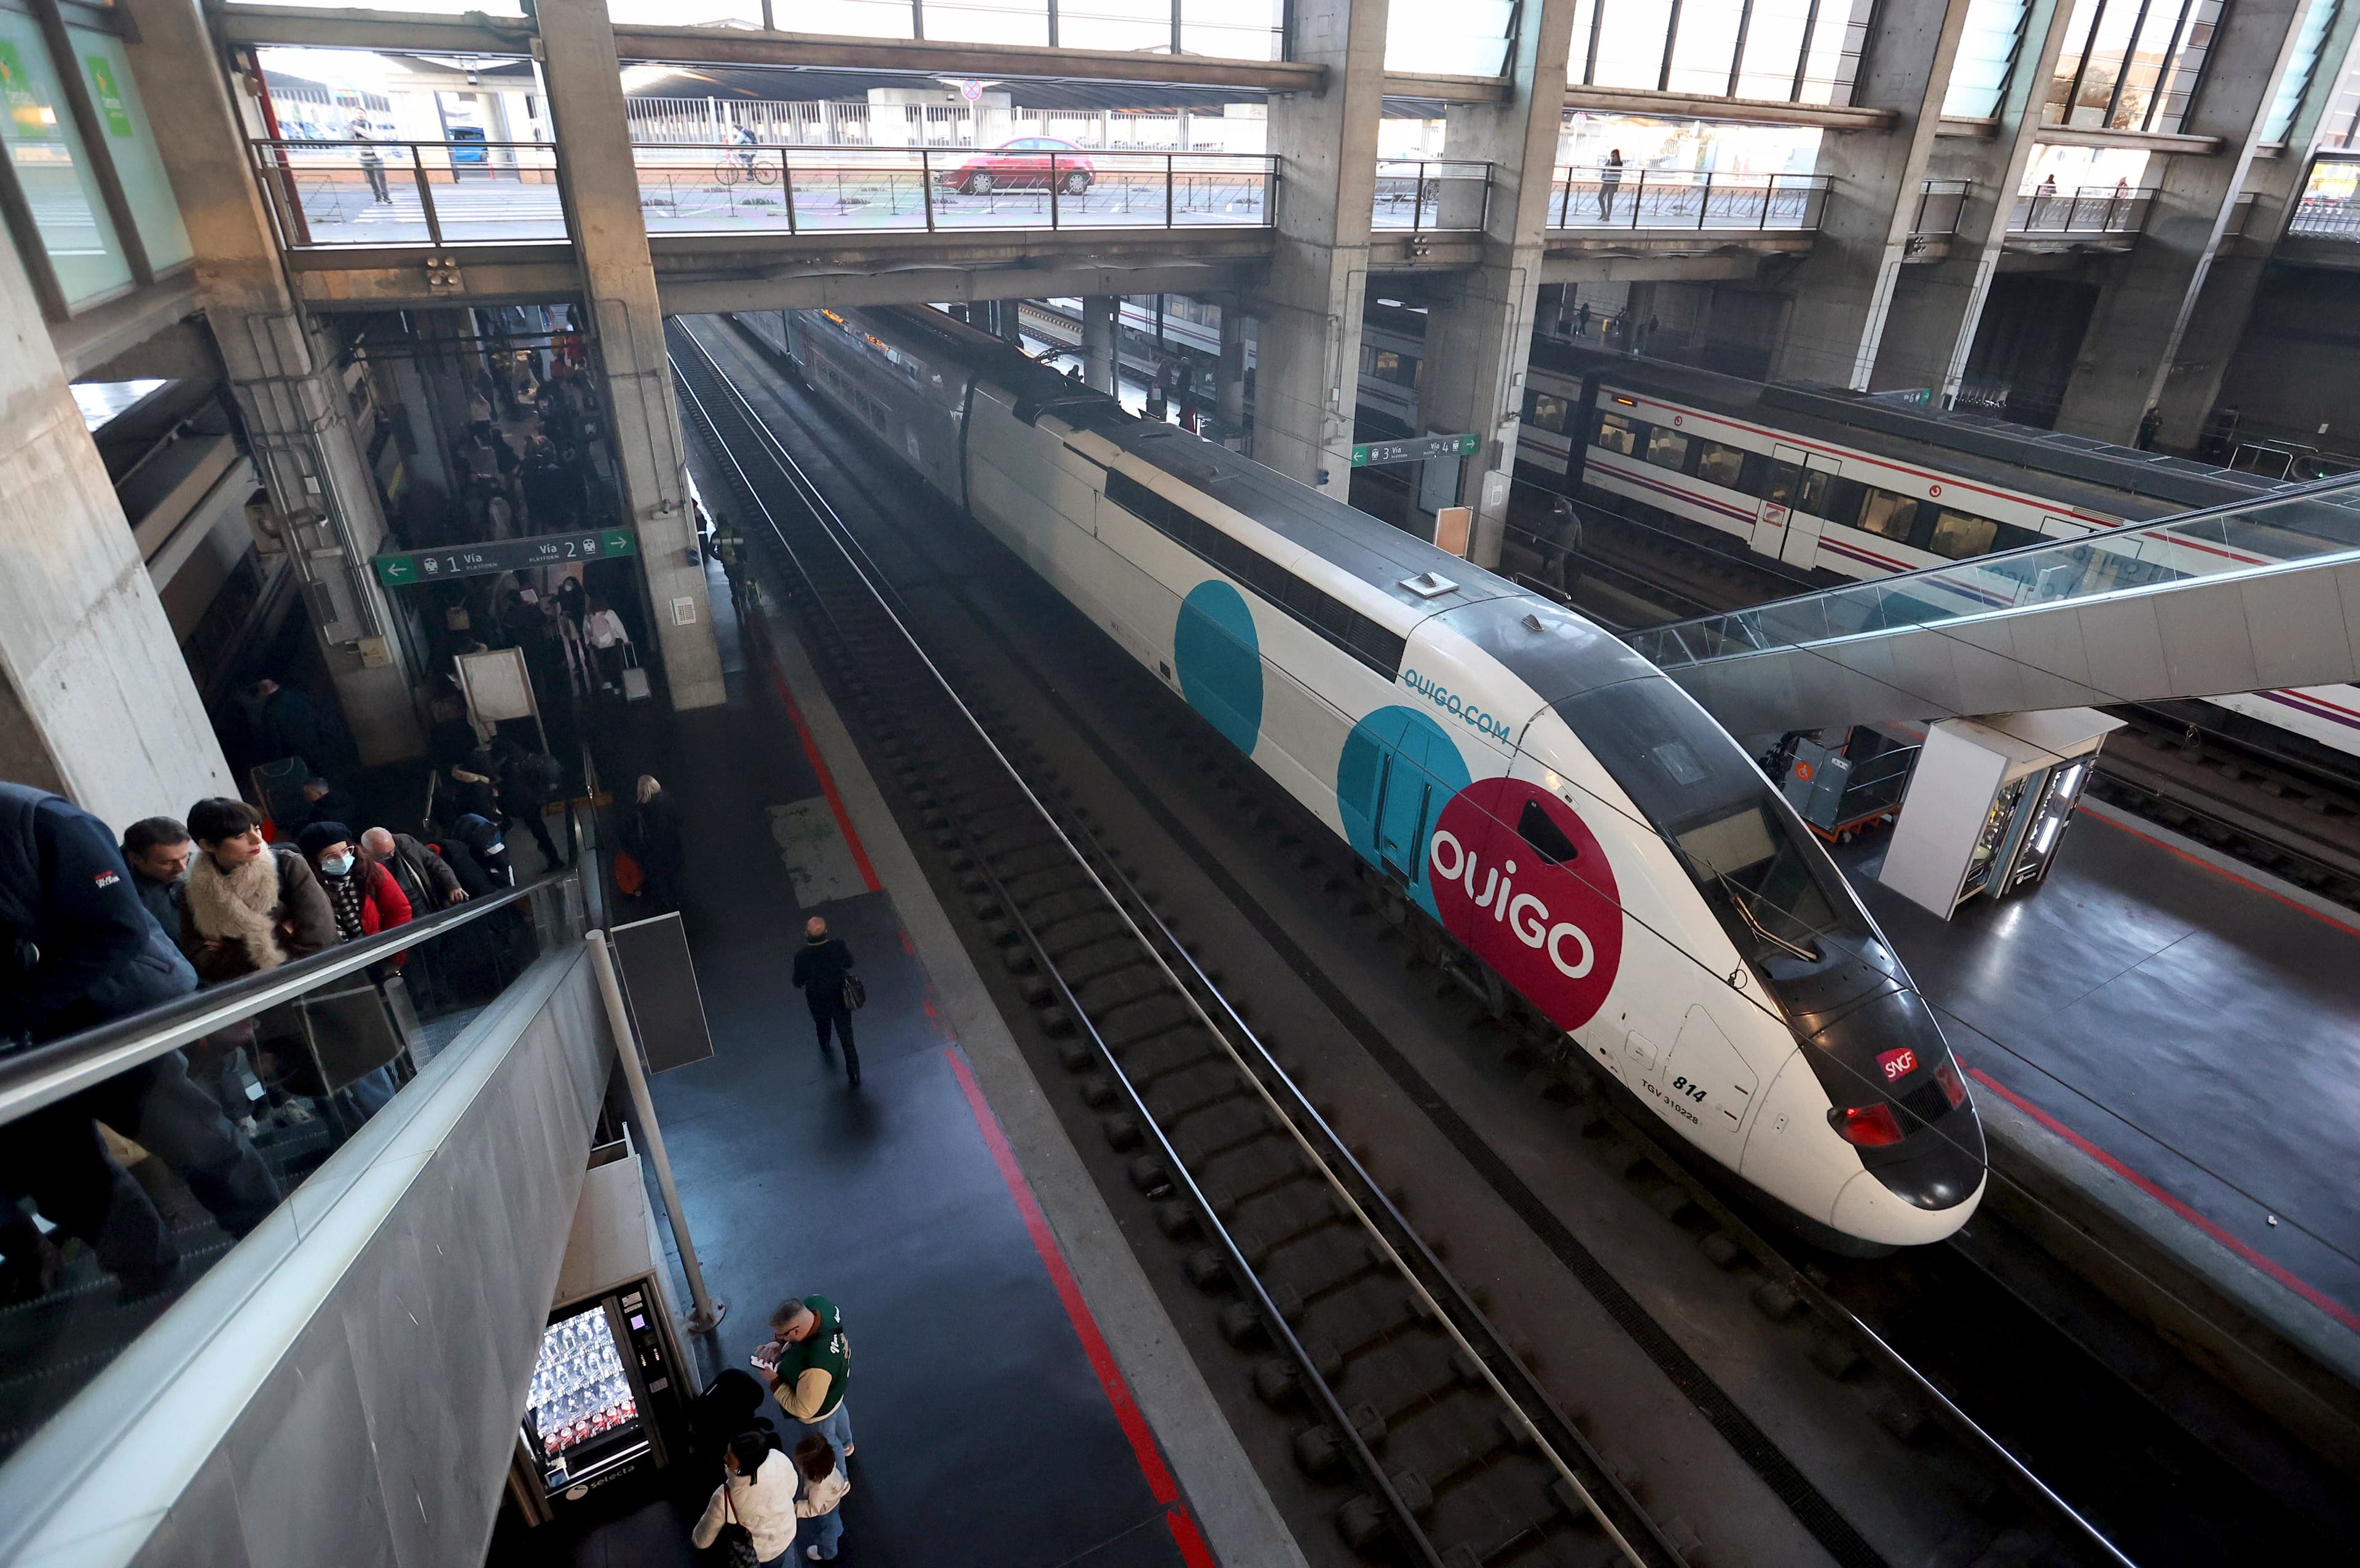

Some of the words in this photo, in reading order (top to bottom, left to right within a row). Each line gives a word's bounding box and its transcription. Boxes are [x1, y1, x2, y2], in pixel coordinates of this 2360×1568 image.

[1909, 393, 1914, 403] 6
[1383, 447, 1390, 460] 3
[1442, 442, 1449, 452] 4
[539, 543, 557, 554] Vía
[564, 541, 576, 558] 2
[447, 556, 461, 573] 1
[463, 553, 482, 563] Vía
[1405, 668, 1510, 745] OUIGO.COM
[1885, 1051, 1912, 1078] SNCF
[1673, 1076, 1707, 1103] 814
[1642, 1078, 1662, 1097] TGV
[1663, 1096, 1699, 1124] 310228
[590, 1465, 635, 1489] selecta
